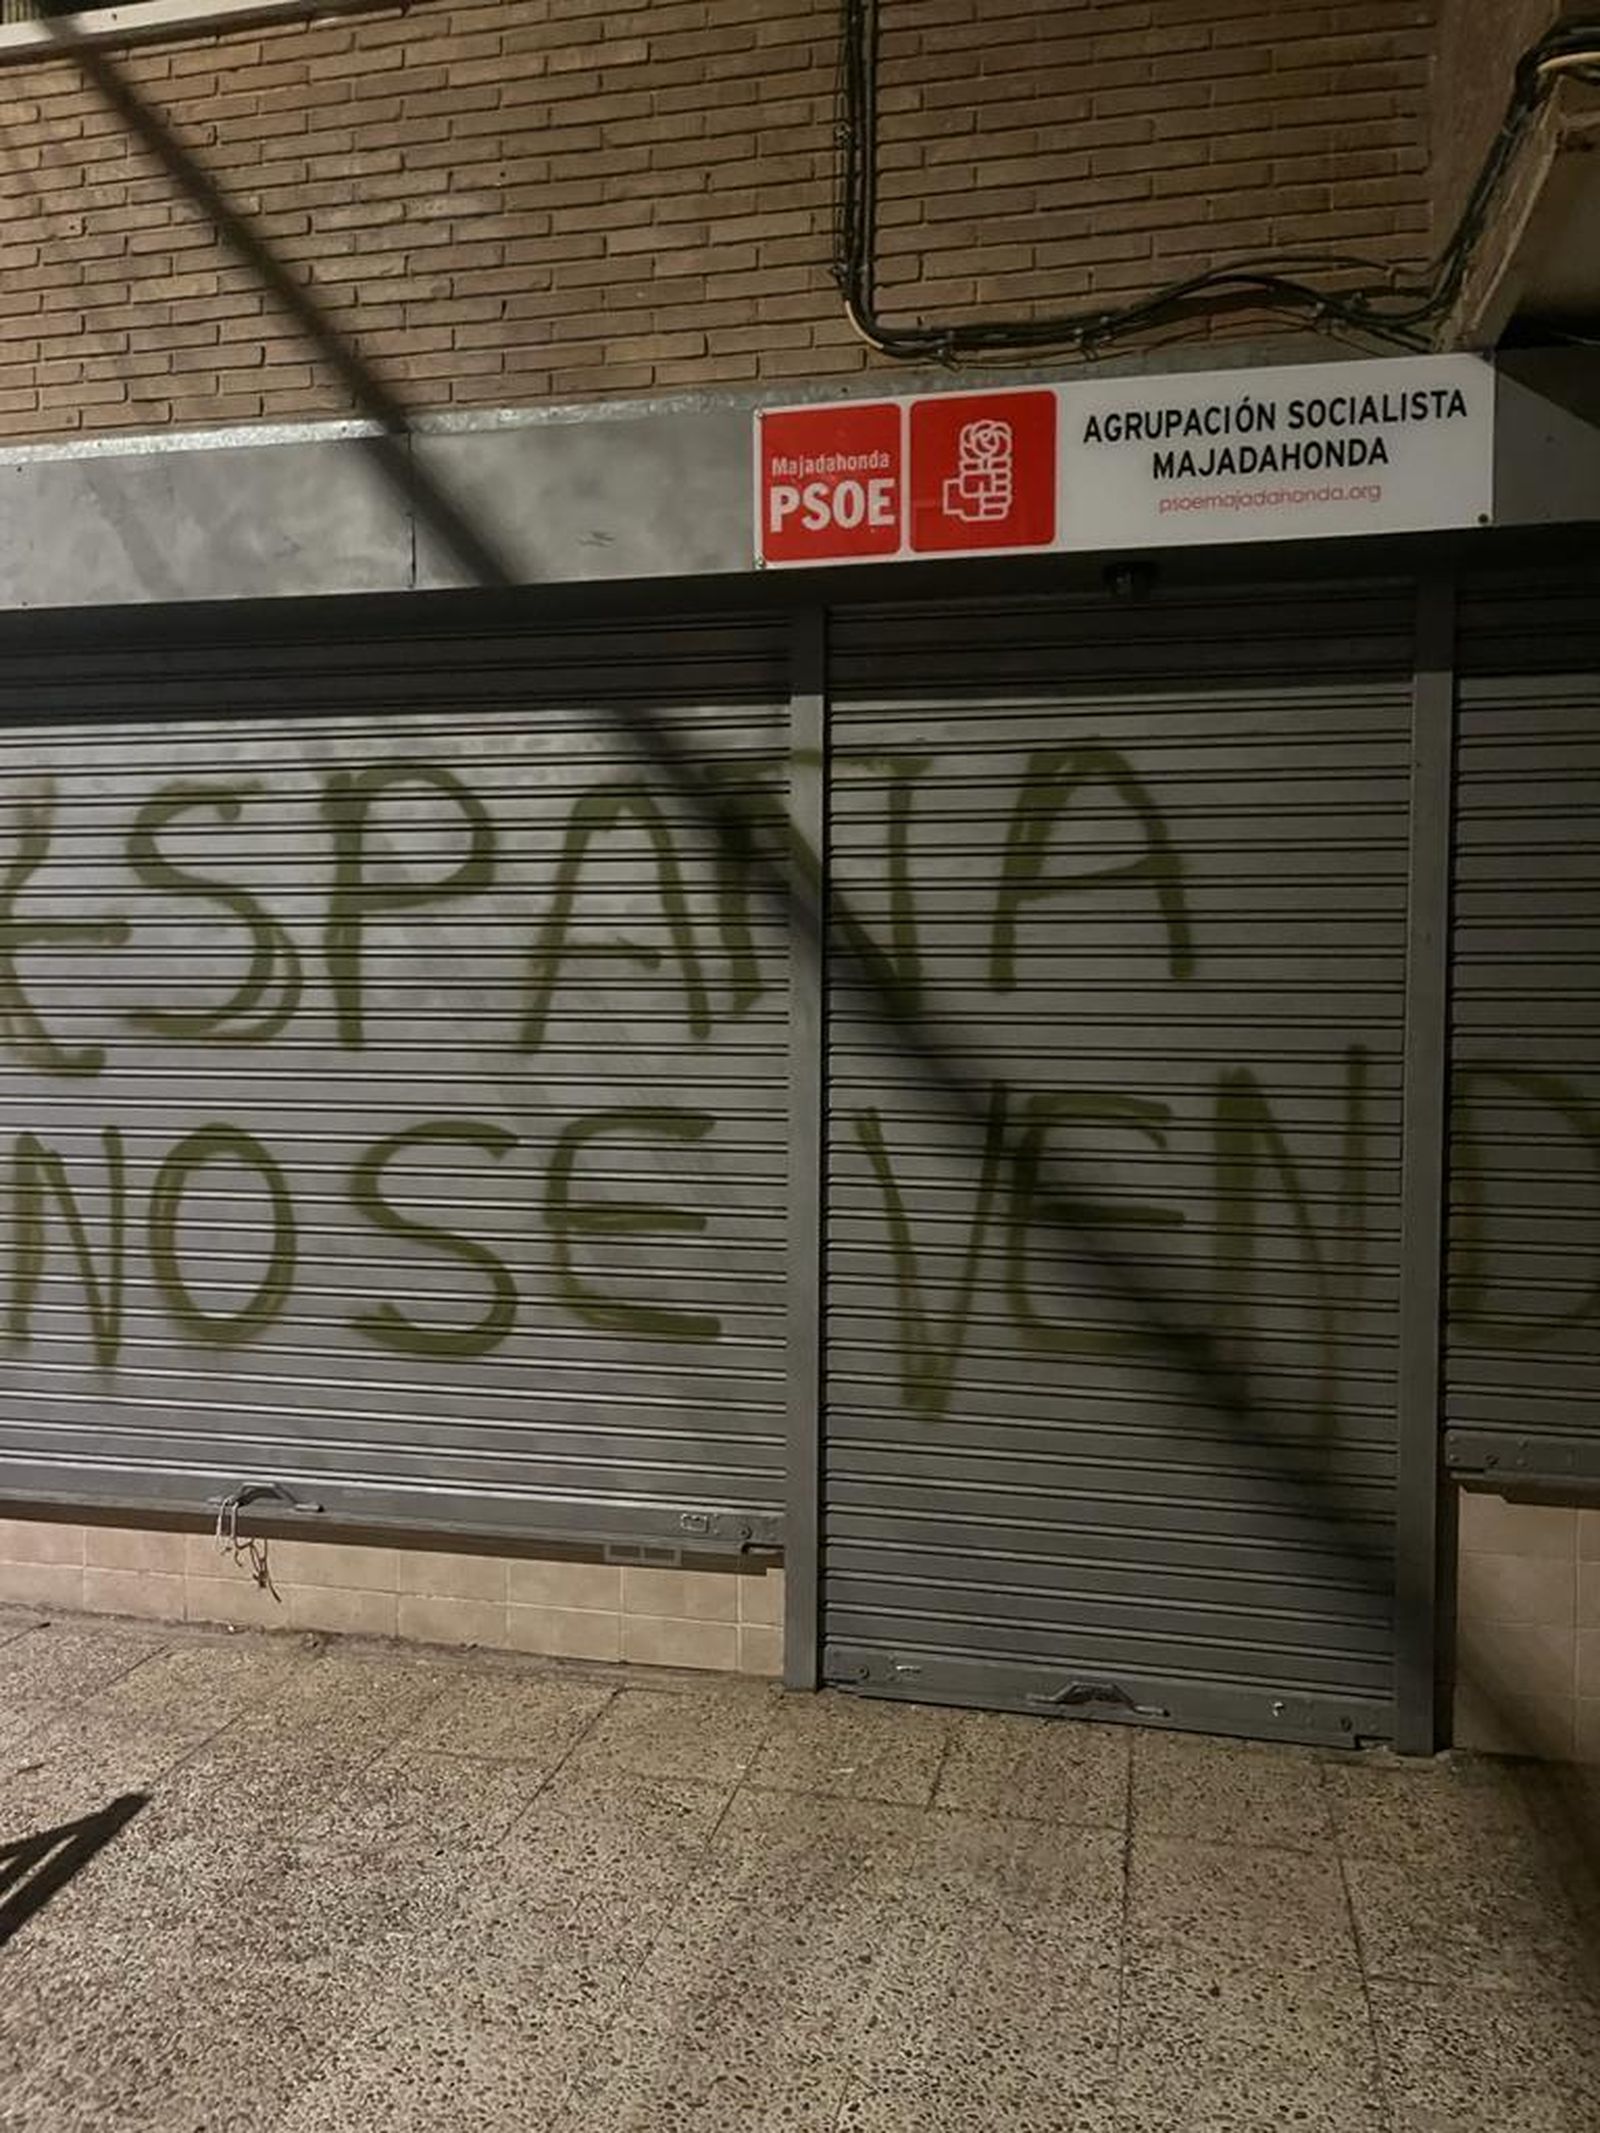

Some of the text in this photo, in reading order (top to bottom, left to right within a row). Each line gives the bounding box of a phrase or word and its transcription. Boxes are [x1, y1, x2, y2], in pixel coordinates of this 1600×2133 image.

[1082, 388, 1468, 444] AGRUPACIÓN SOCIALISTA
[771, 450, 890, 479] Majadahonda
[1152, 437, 1389, 480] MAJADAHONDA
[769, 478, 896, 534] PSOE
[1158, 482, 1382, 515] psoemajadahonda.org
